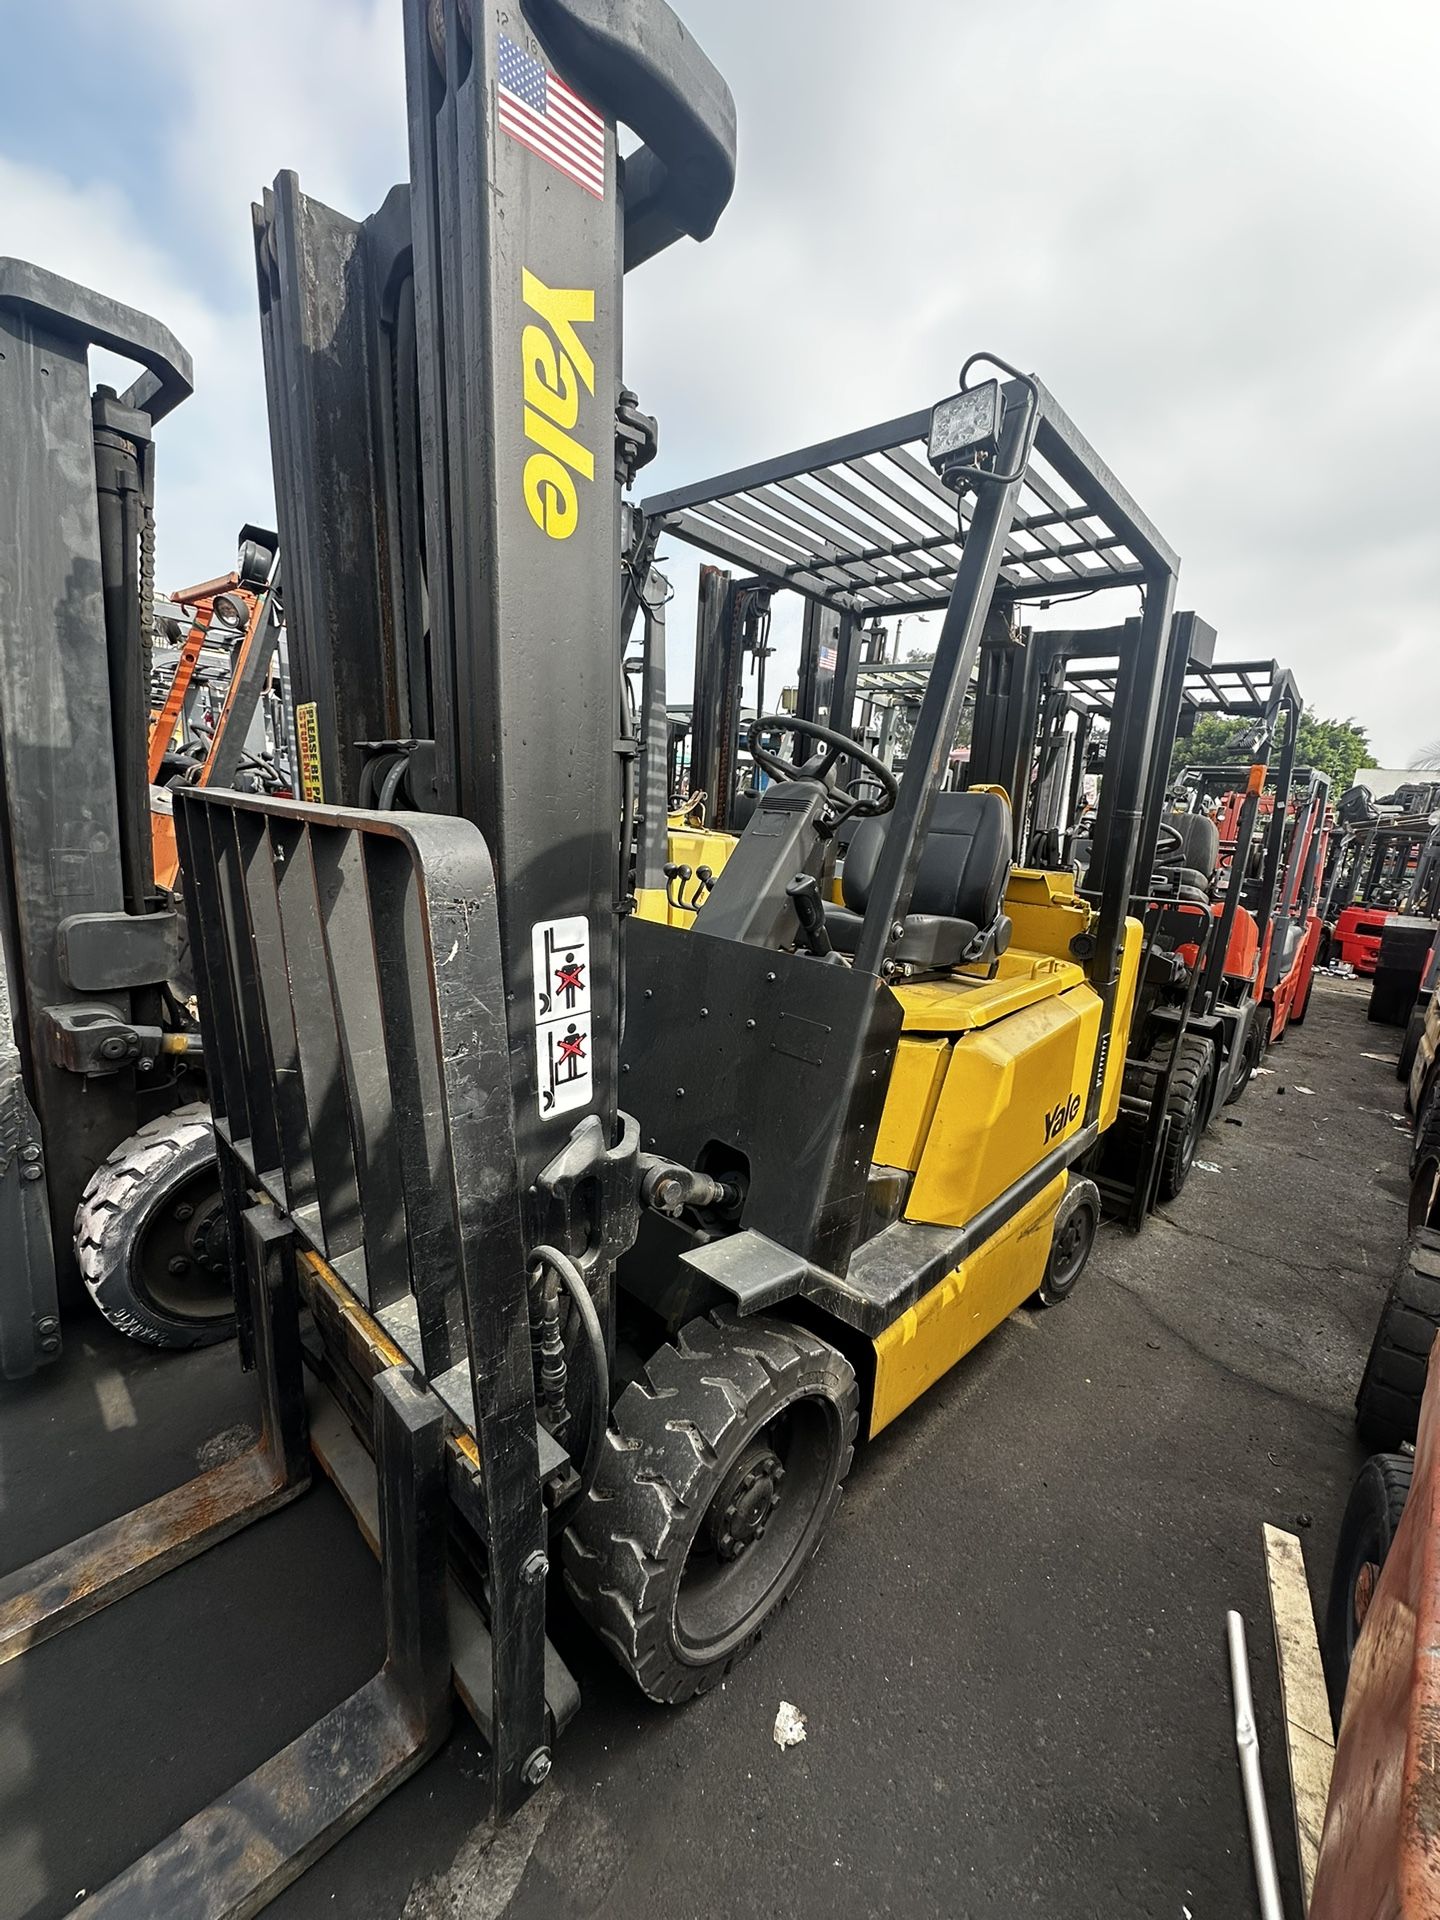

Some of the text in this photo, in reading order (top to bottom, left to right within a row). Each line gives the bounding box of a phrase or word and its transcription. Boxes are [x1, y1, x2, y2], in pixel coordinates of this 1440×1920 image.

[521, 265, 595, 540] Yale
[299, 710, 311, 783] STUDENT
[306, 708, 318, 761] PLEASE
[310, 764, 320, 783] BE
[1043, 1092, 1081, 1146] Yale
